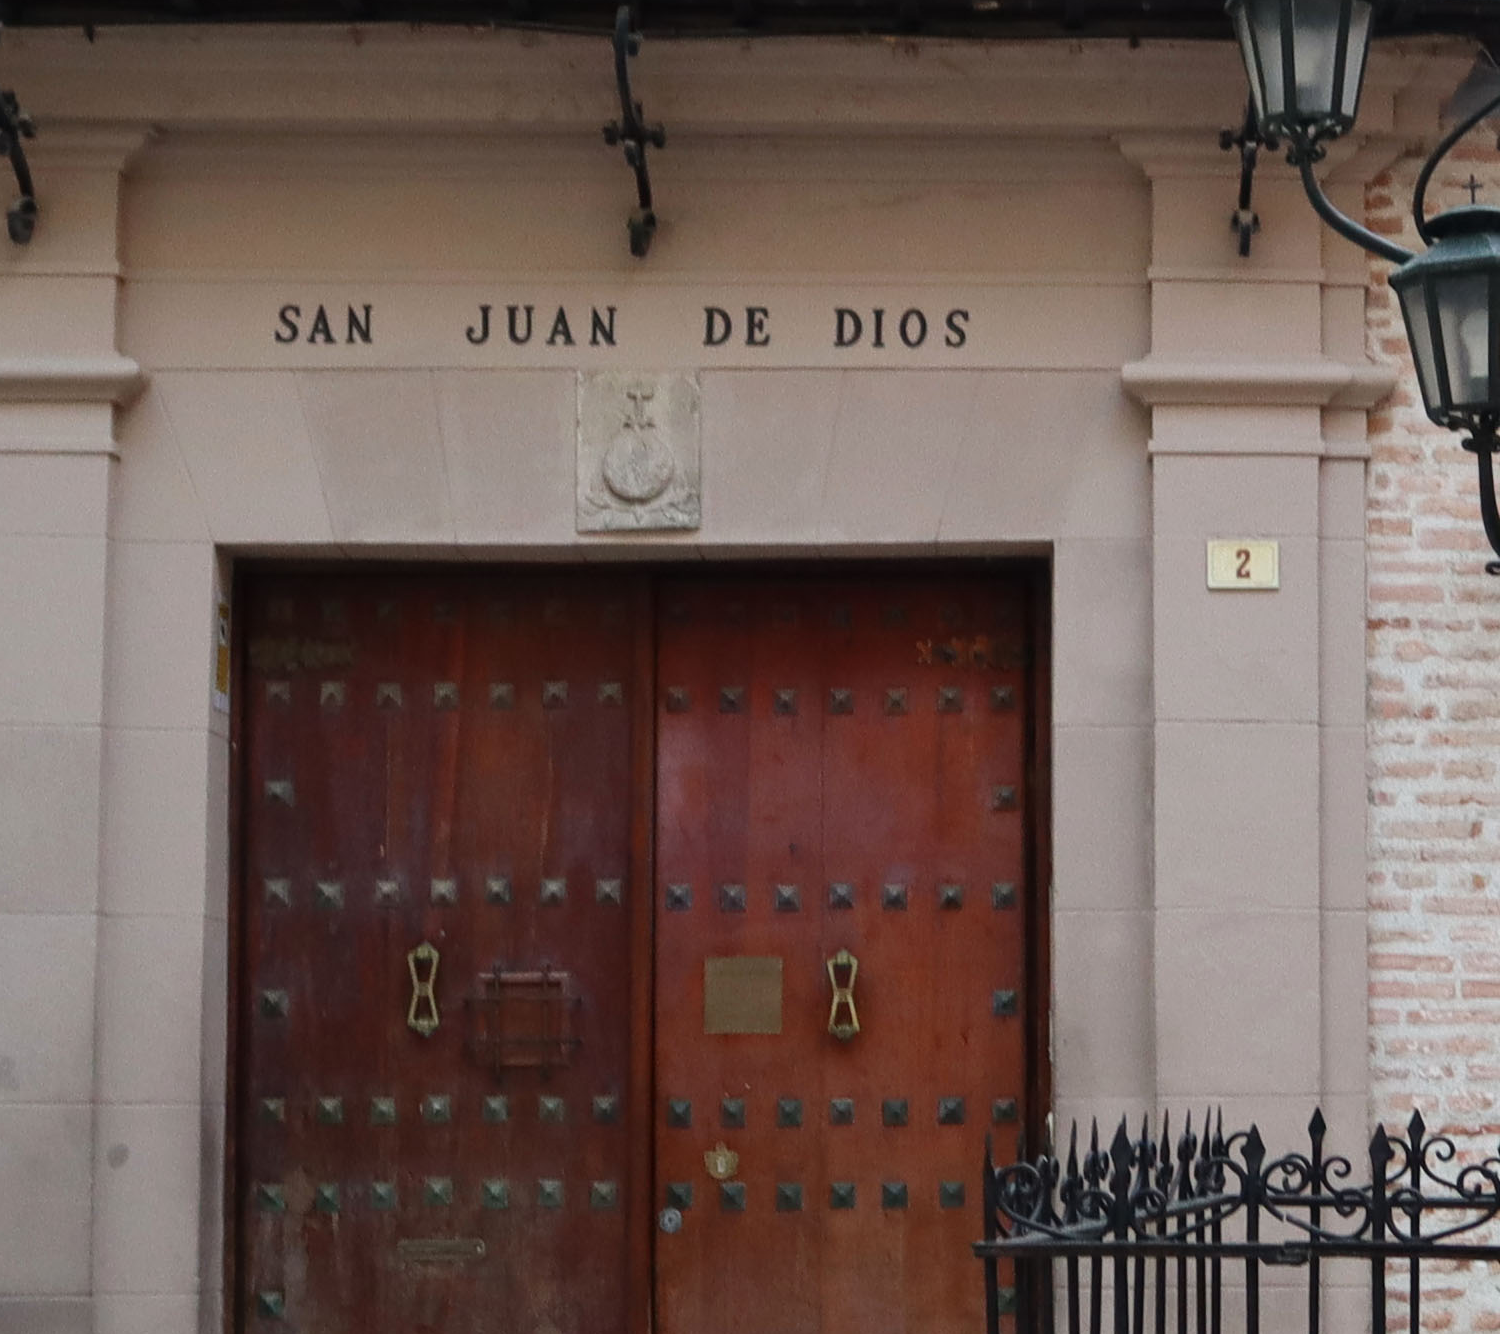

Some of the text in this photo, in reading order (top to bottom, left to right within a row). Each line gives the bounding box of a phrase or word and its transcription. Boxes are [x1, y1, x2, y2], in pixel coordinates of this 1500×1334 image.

[275, 304, 969, 348] SAN JUAN DE DIOS
[1236, 549, 1250, 578] 2
